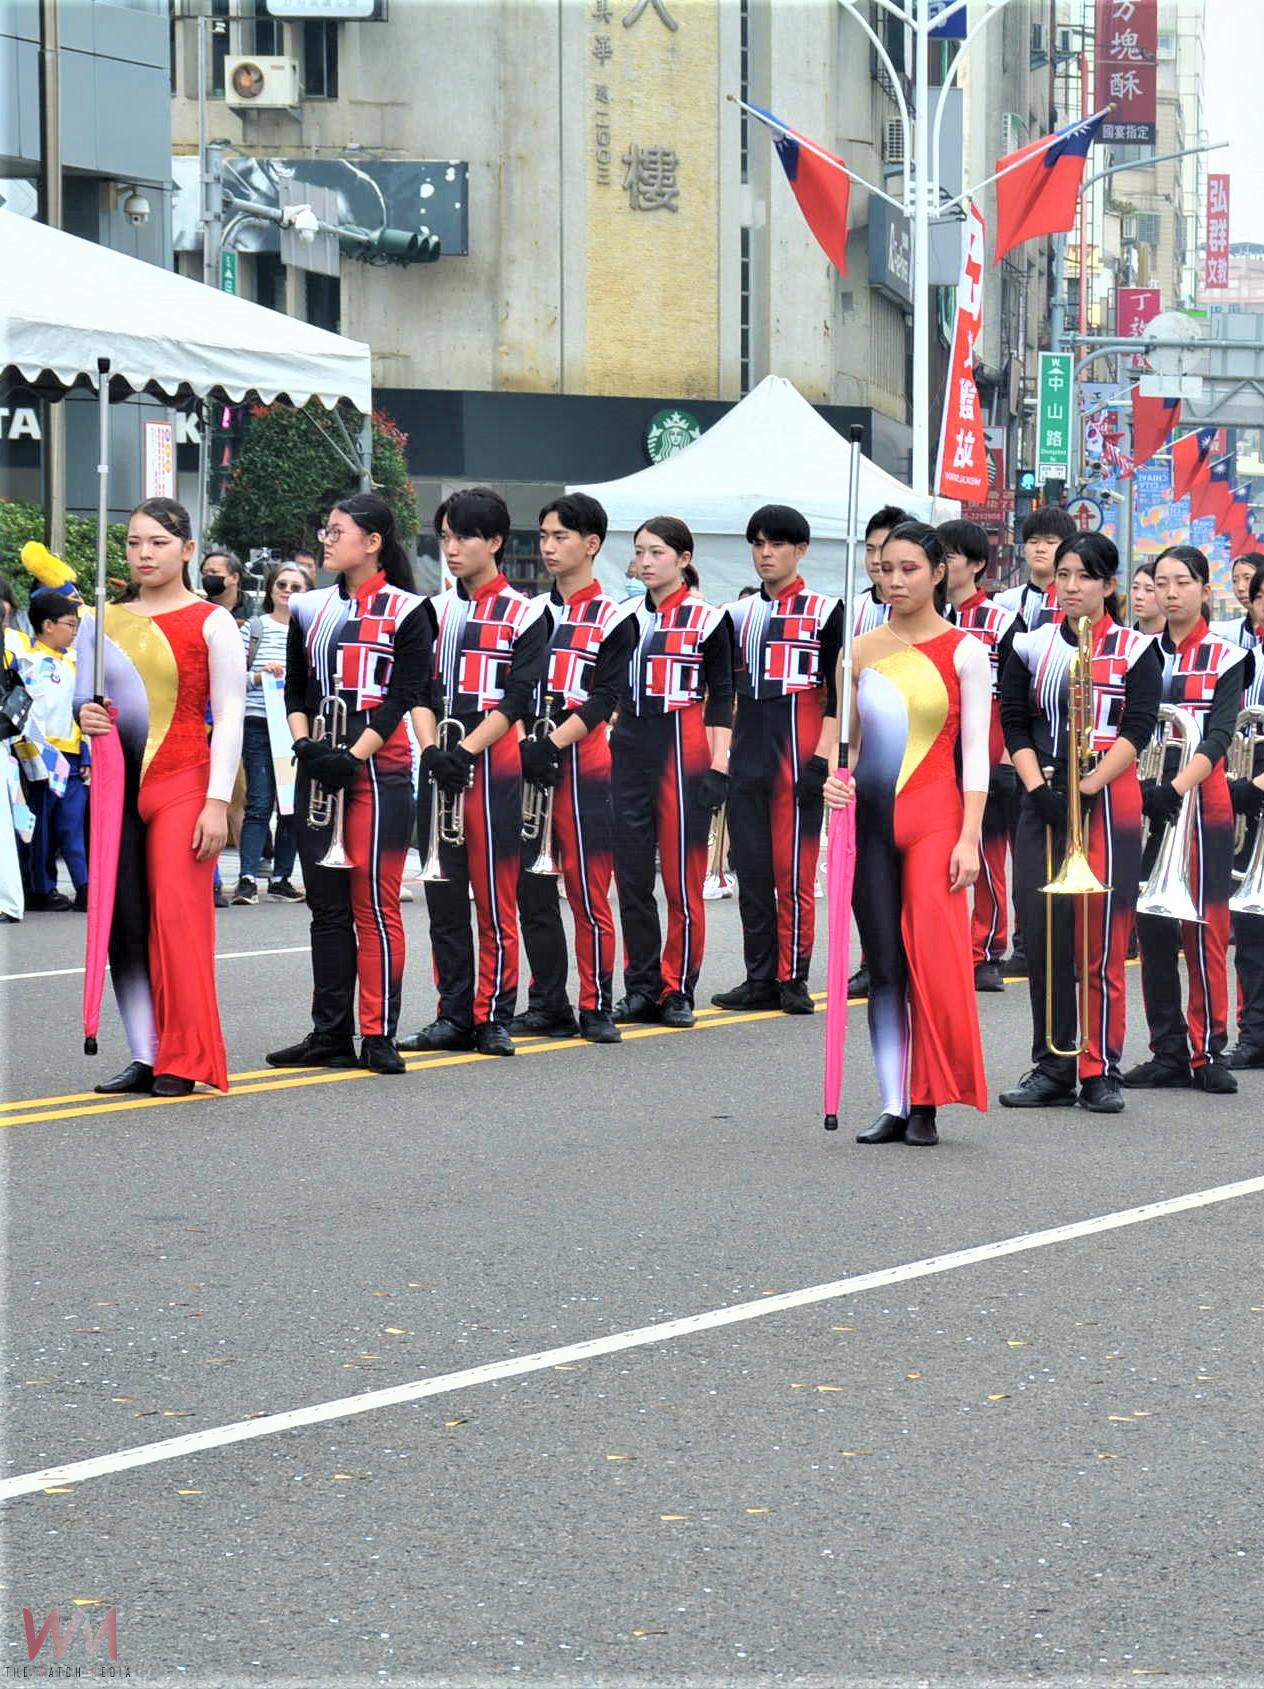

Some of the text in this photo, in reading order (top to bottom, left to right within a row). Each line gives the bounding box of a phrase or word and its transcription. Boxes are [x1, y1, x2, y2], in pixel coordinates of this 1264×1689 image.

[1109, 0, 1143, 101] 方塊酥
[1046, 376, 1064, 447] 中山路
